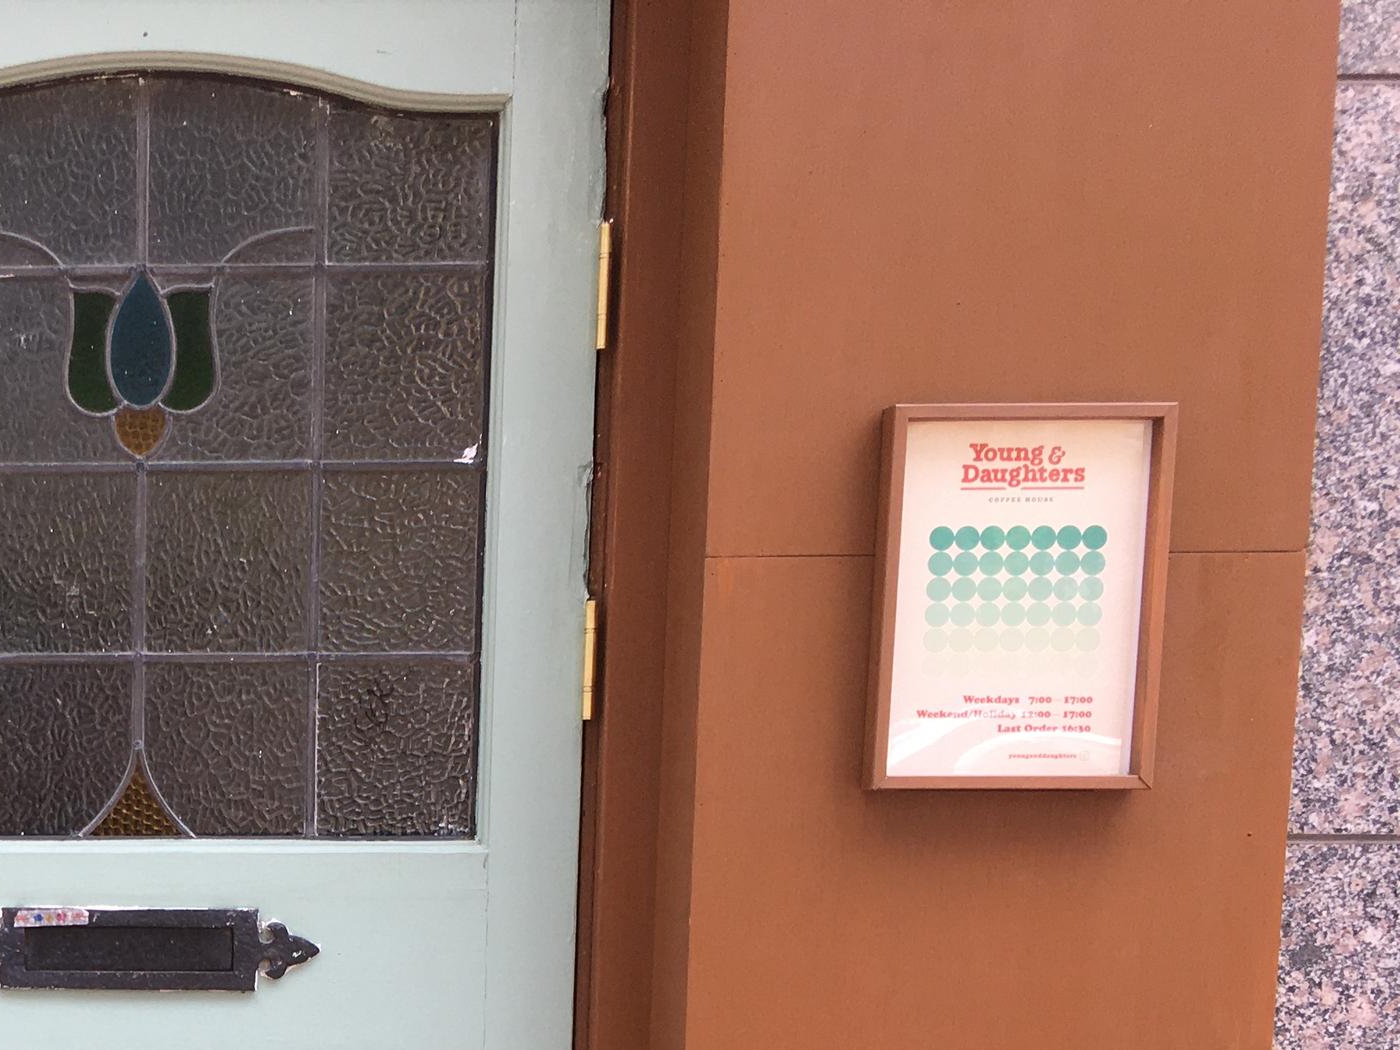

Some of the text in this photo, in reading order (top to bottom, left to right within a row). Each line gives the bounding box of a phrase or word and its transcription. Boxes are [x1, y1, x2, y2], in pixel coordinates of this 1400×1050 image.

[969, 443, 1066, 466] Young &
[961, 464, 1085, 487] Daughters
[963, 695, 1020, 705] Weekdays
[1028, 696, 1052, 705] 7:00
[1063, 696, 1093, 705] 17:00
[1062, 710, 1092, 719] 17:00
[997, 724, 1021, 733] Last
[1024, 724, 1058, 733] Order
